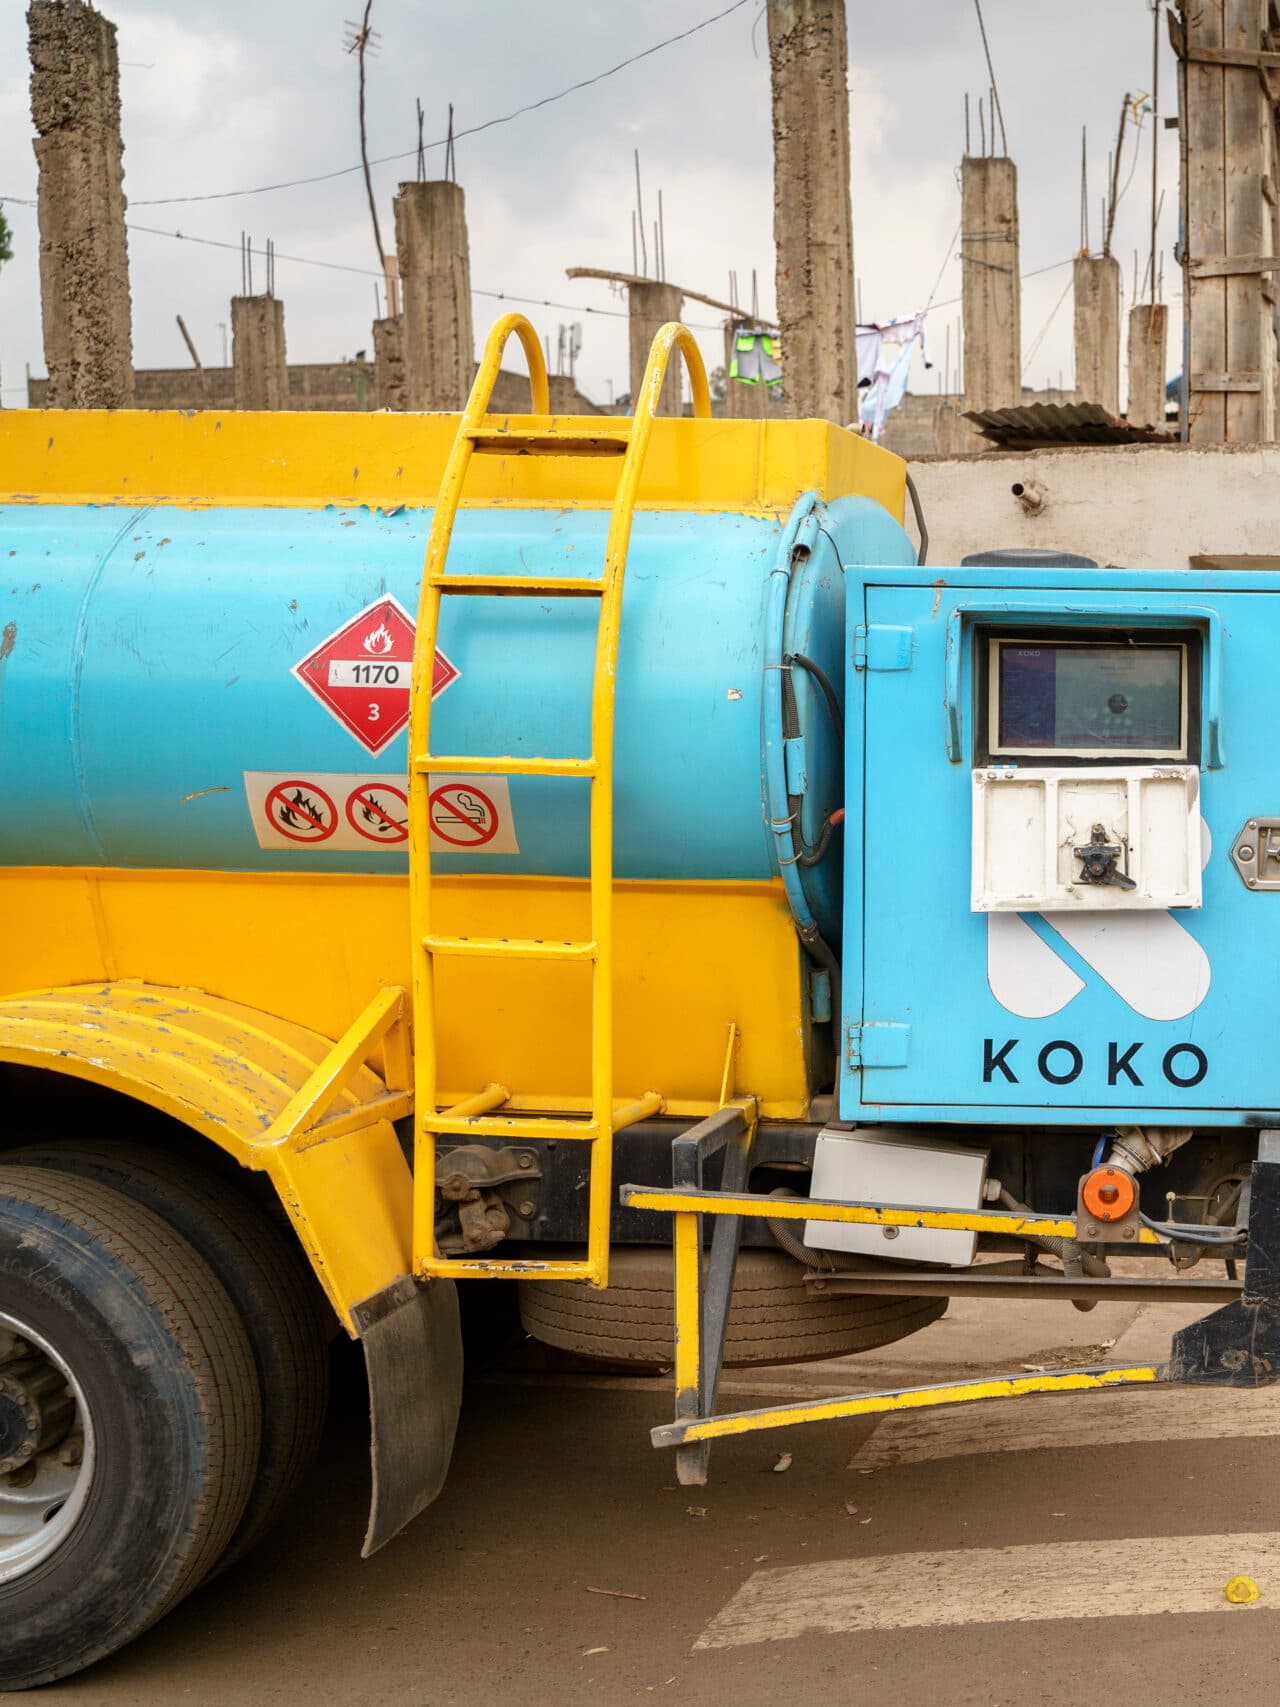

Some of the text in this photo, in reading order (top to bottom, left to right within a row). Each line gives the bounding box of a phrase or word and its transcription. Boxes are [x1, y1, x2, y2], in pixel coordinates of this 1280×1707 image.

[351, 664, 400, 685] 1170
[367, 703, 381, 721] 3
[982, 1038, 1209, 1088] KOKO
